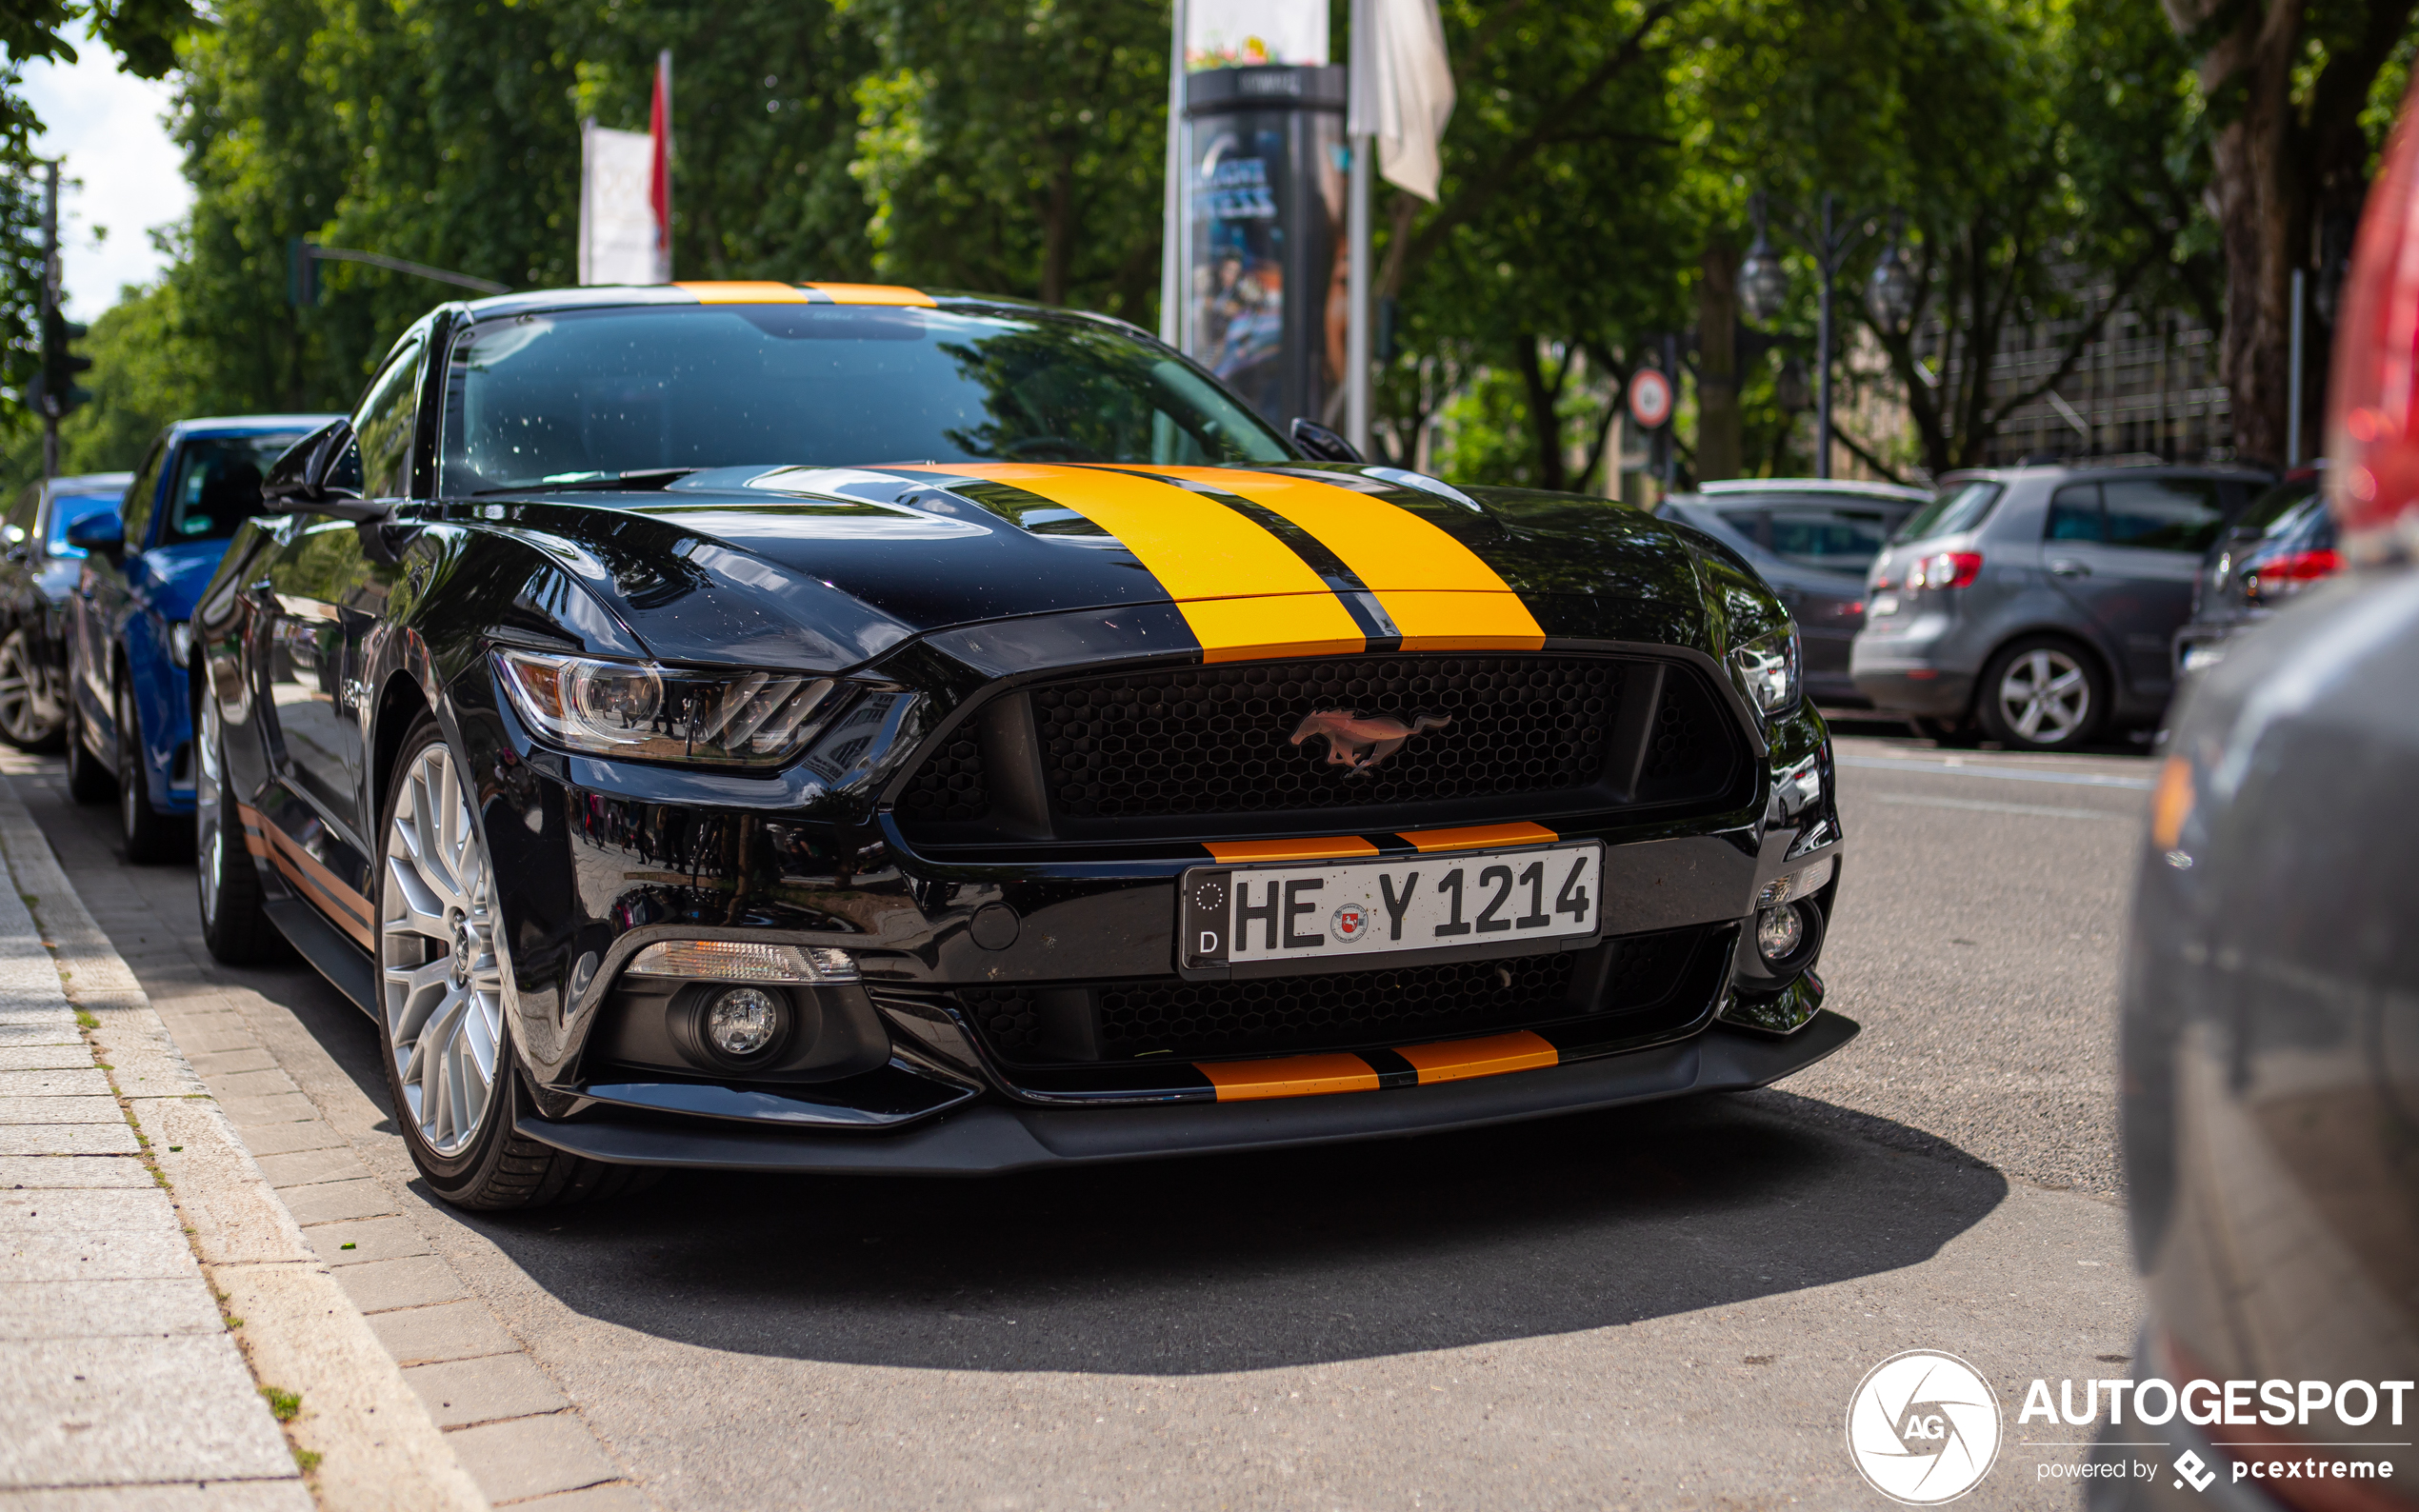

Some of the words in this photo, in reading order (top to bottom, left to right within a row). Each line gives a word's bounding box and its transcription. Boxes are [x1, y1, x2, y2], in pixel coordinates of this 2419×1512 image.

[1235, 879, 1325, 951] HE
[1379, 871, 1419, 941] Y
[1434, 856, 1590, 937] 1214
[1200, 931, 1217, 952] D
